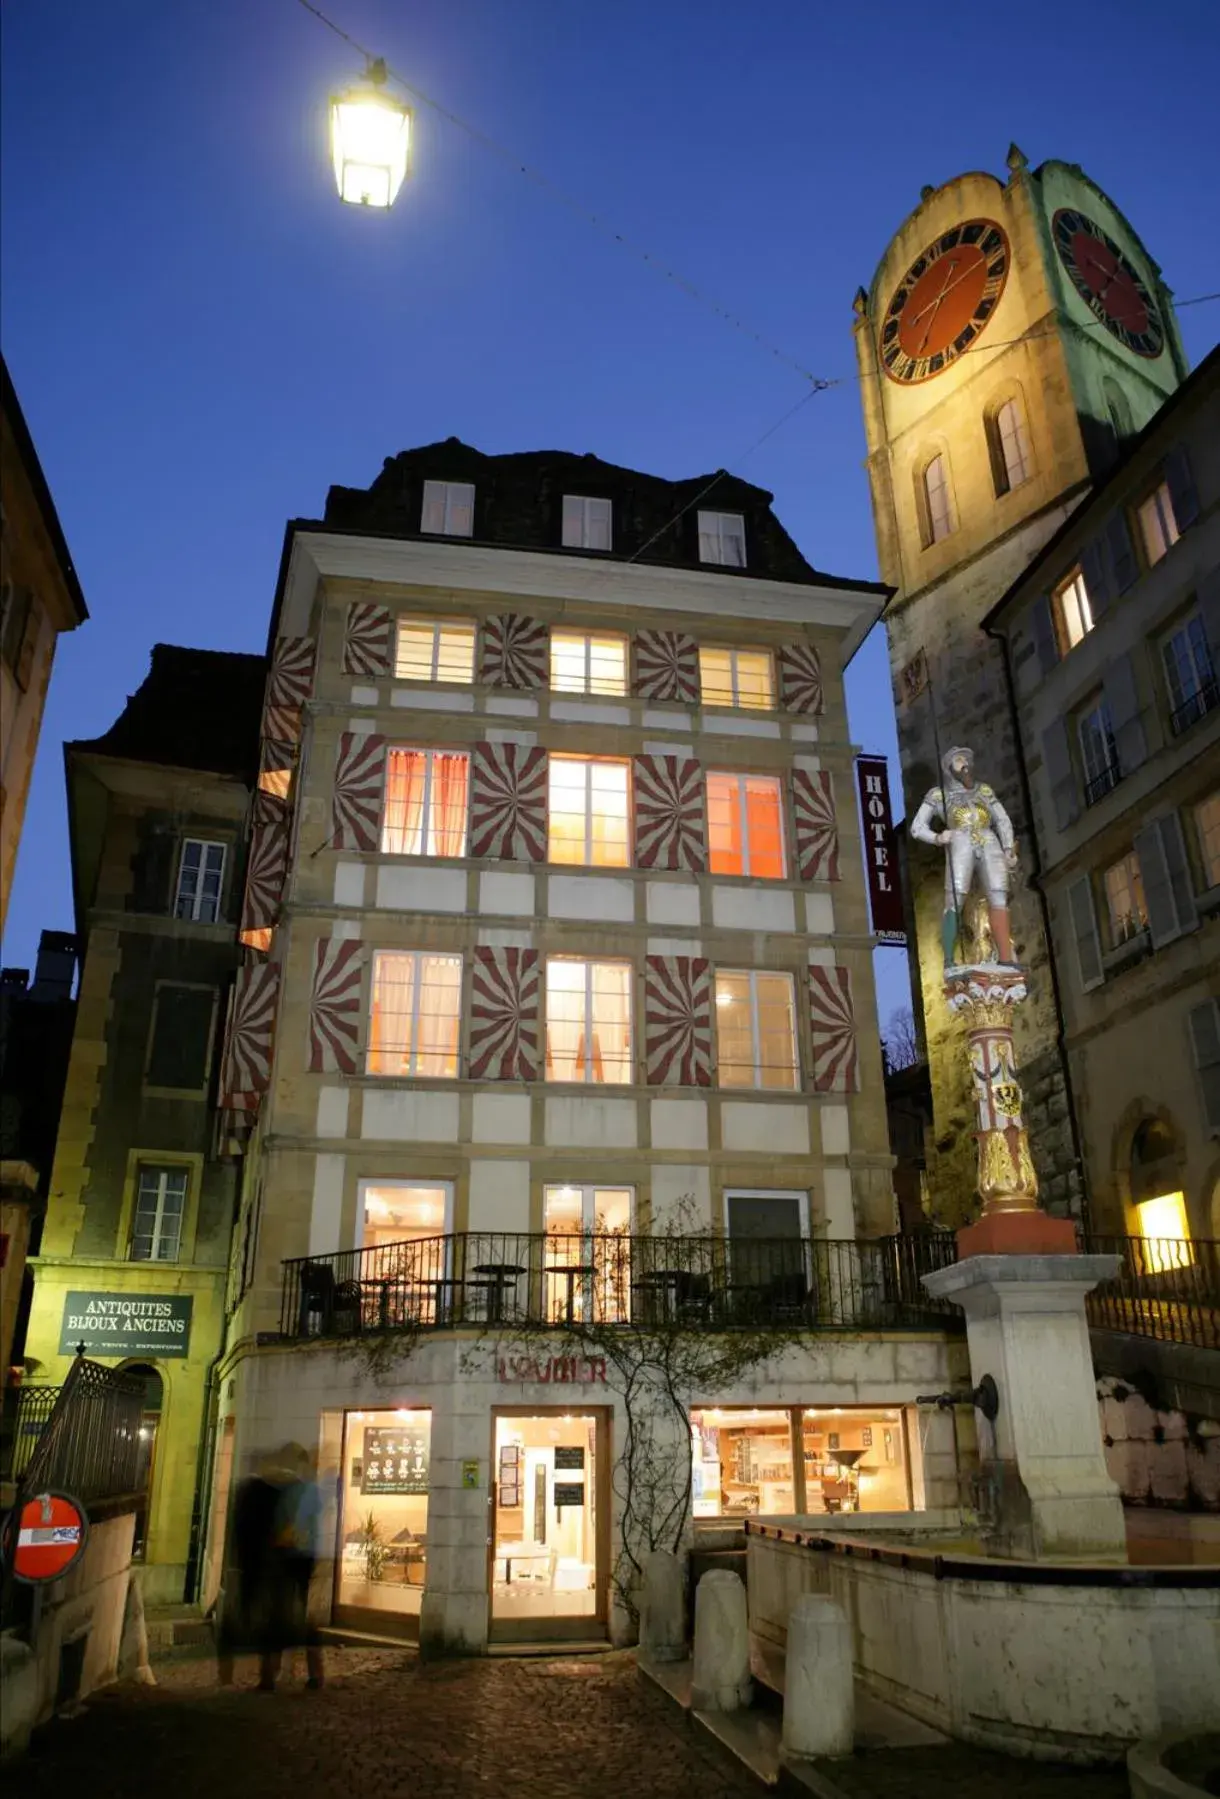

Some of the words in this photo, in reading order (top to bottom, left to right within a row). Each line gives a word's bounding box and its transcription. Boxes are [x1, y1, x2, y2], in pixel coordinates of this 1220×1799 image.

[865, 774, 892, 892] HÔTEL
[86, 1300, 172, 1317] ANTIQUITES
[67, 1315, 119, 1331] BIJOUX
[123, 1317, 185, 1334] ANCIENS
